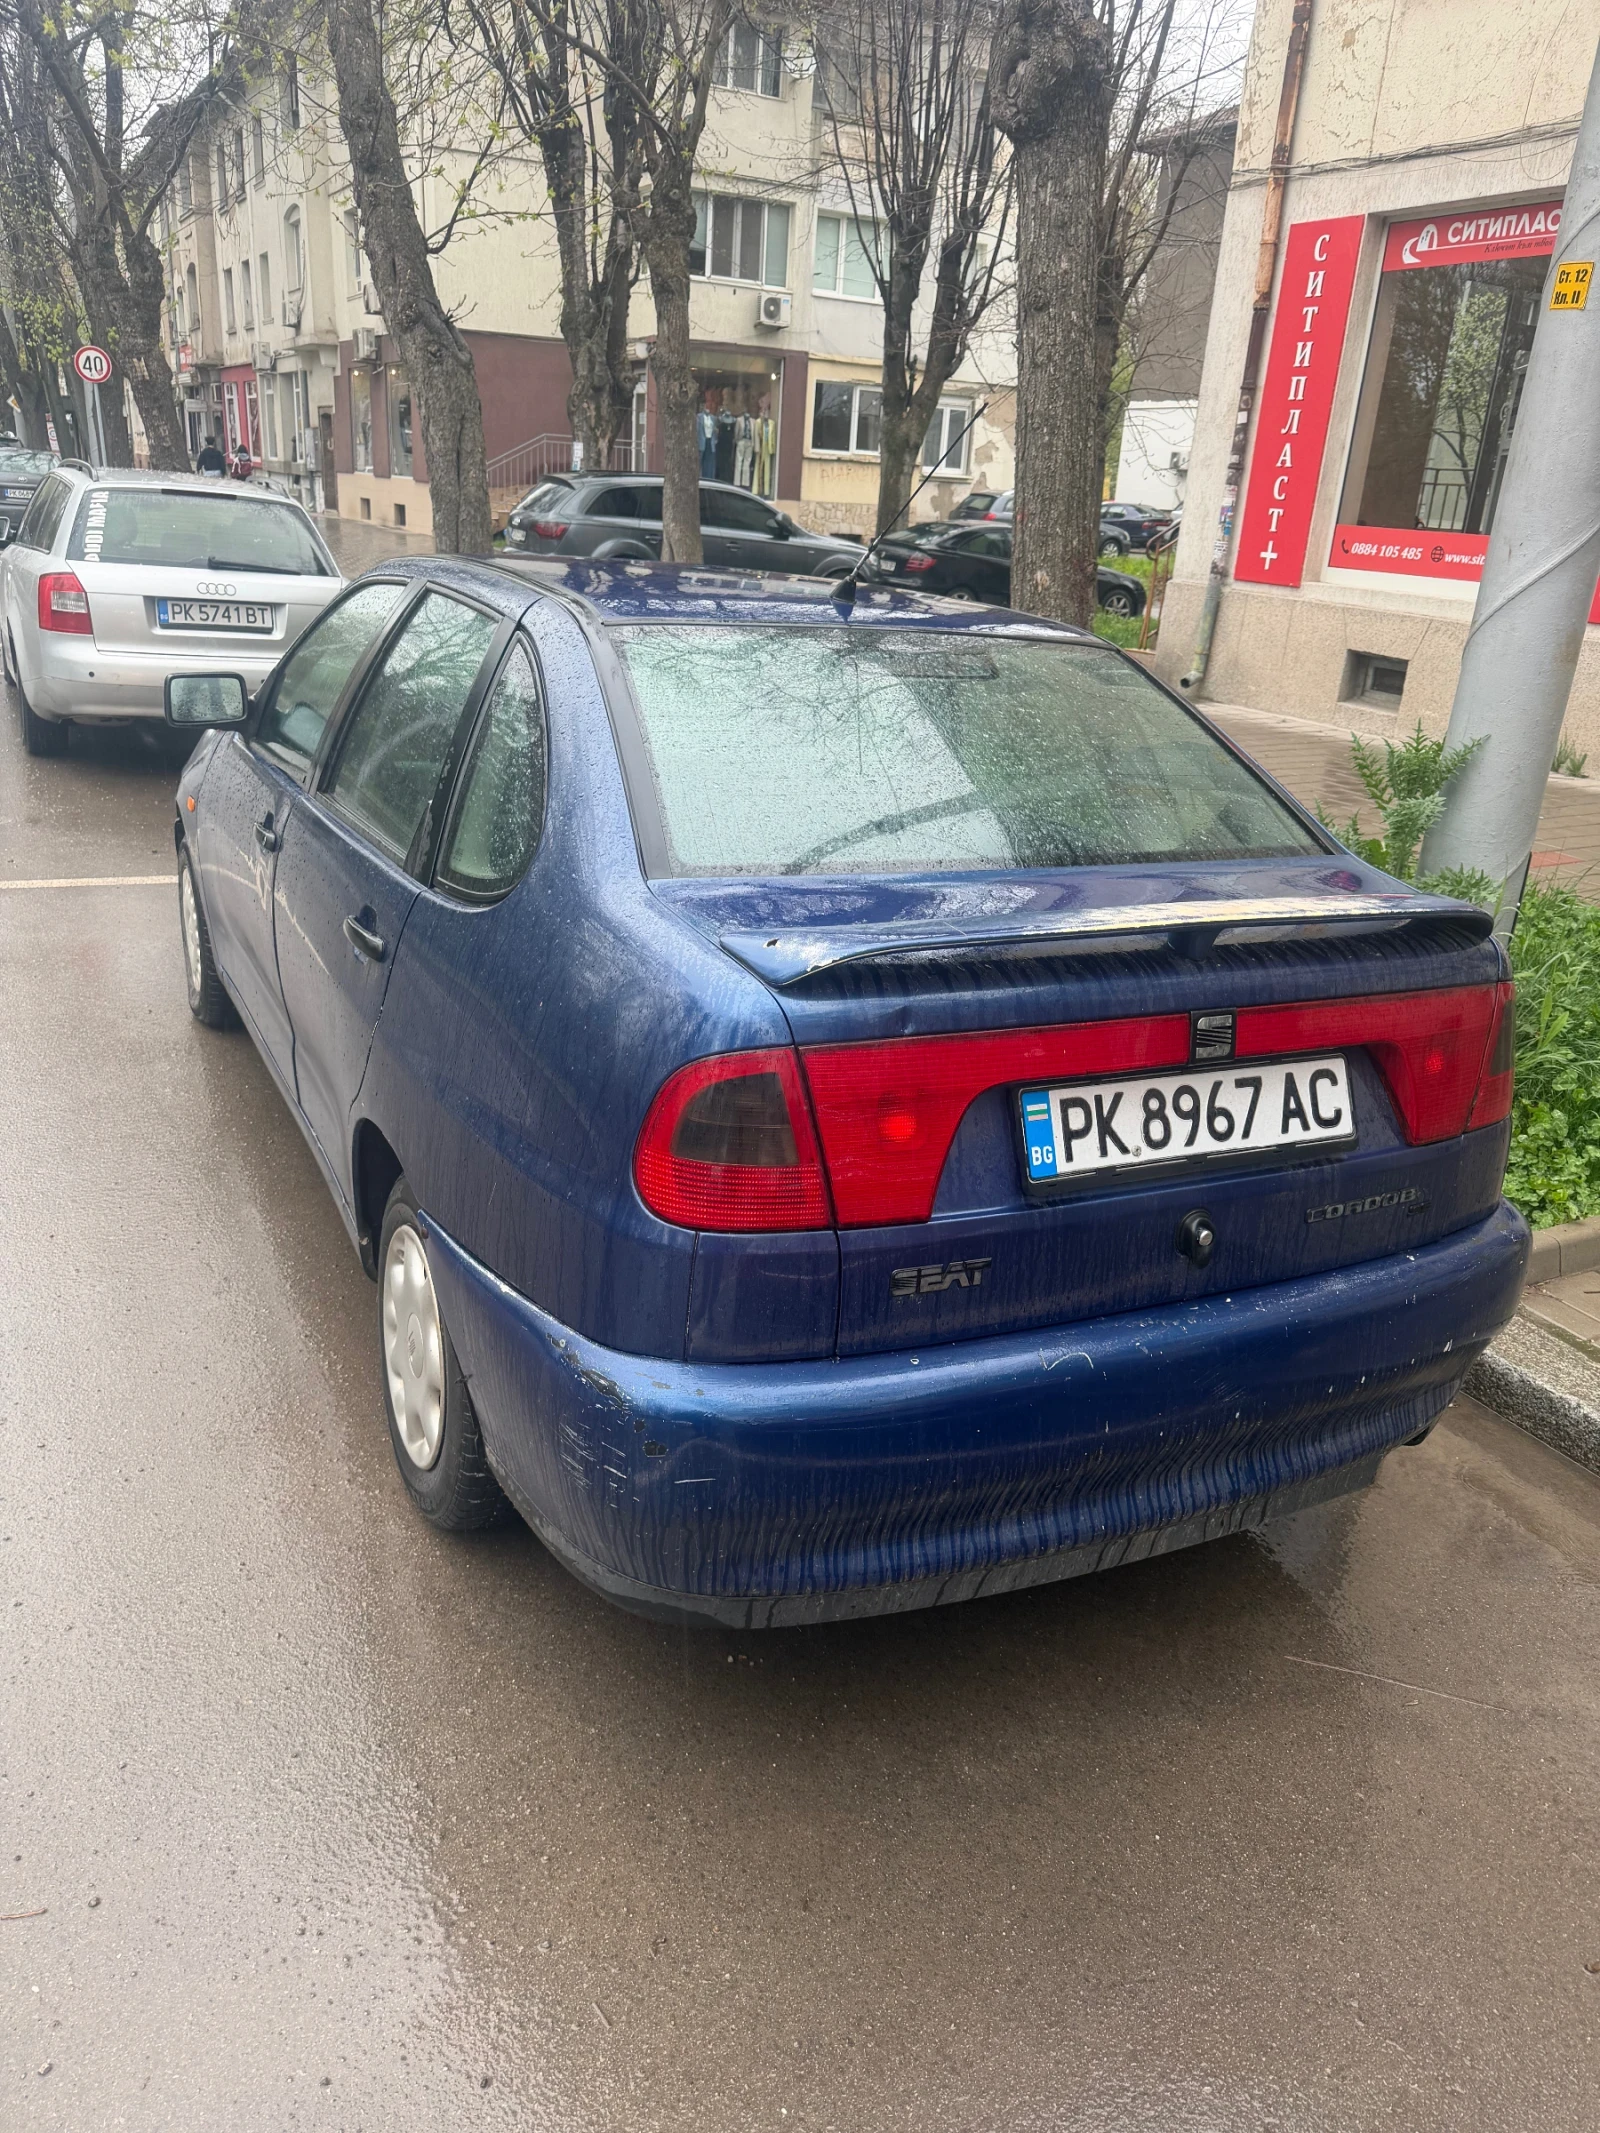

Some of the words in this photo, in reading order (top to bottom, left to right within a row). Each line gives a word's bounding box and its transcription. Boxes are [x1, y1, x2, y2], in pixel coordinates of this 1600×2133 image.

[1575, 269, 1588, 283] 12
[83, 355, 104, 375] 40
[87, 491, 109, 528] MAFIA
[84, 530, 103, 562] AUDI
[1351, 542, 1378, 556] 0884
[1379, 545, 1400, 558] 105
[1401, 547, 1423, 560] 485
[171, 603, 195, 622] PK
[199, 604, 241, 623] 5741
[246, 607, 268, 625] BT
[1059, 1091, 1131, 1163] PK
[1141, 1075, 1262, 1151] 8967
[1281, 1068, 1343, 1135] AC
[1031, 1146, 1053, 1166] BG
[890, 1257, 992, 1298] SEAT
